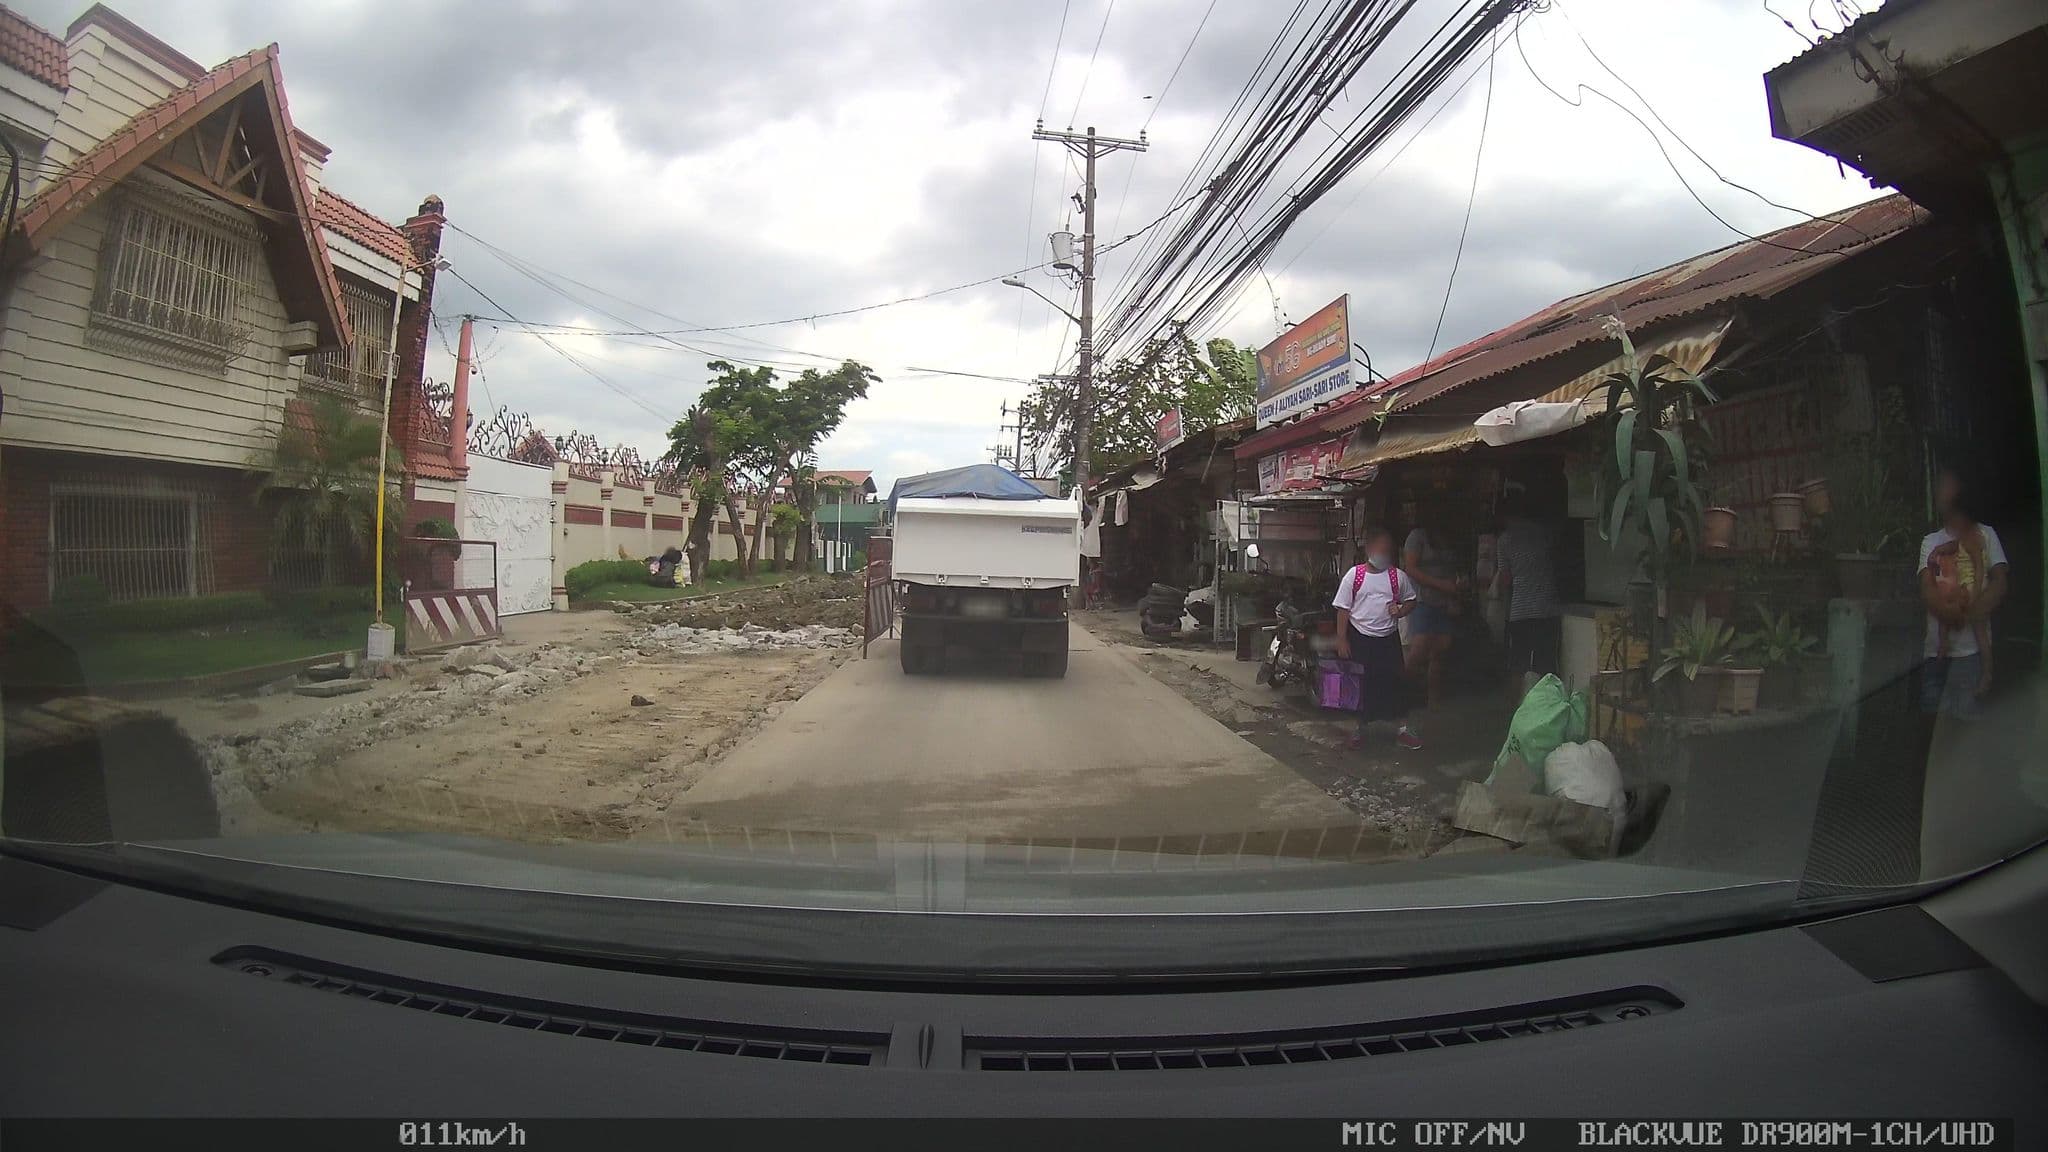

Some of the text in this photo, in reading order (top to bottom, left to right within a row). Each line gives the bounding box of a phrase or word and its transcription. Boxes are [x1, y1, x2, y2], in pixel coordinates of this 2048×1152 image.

[1258, 403, 1275, 422] QUEEN
[1279, 391, 1299, 412] ALIYAH
[1299, 378, 1329, 404] SARI-SARI
[1328, 369, 1350, 391] STORE
